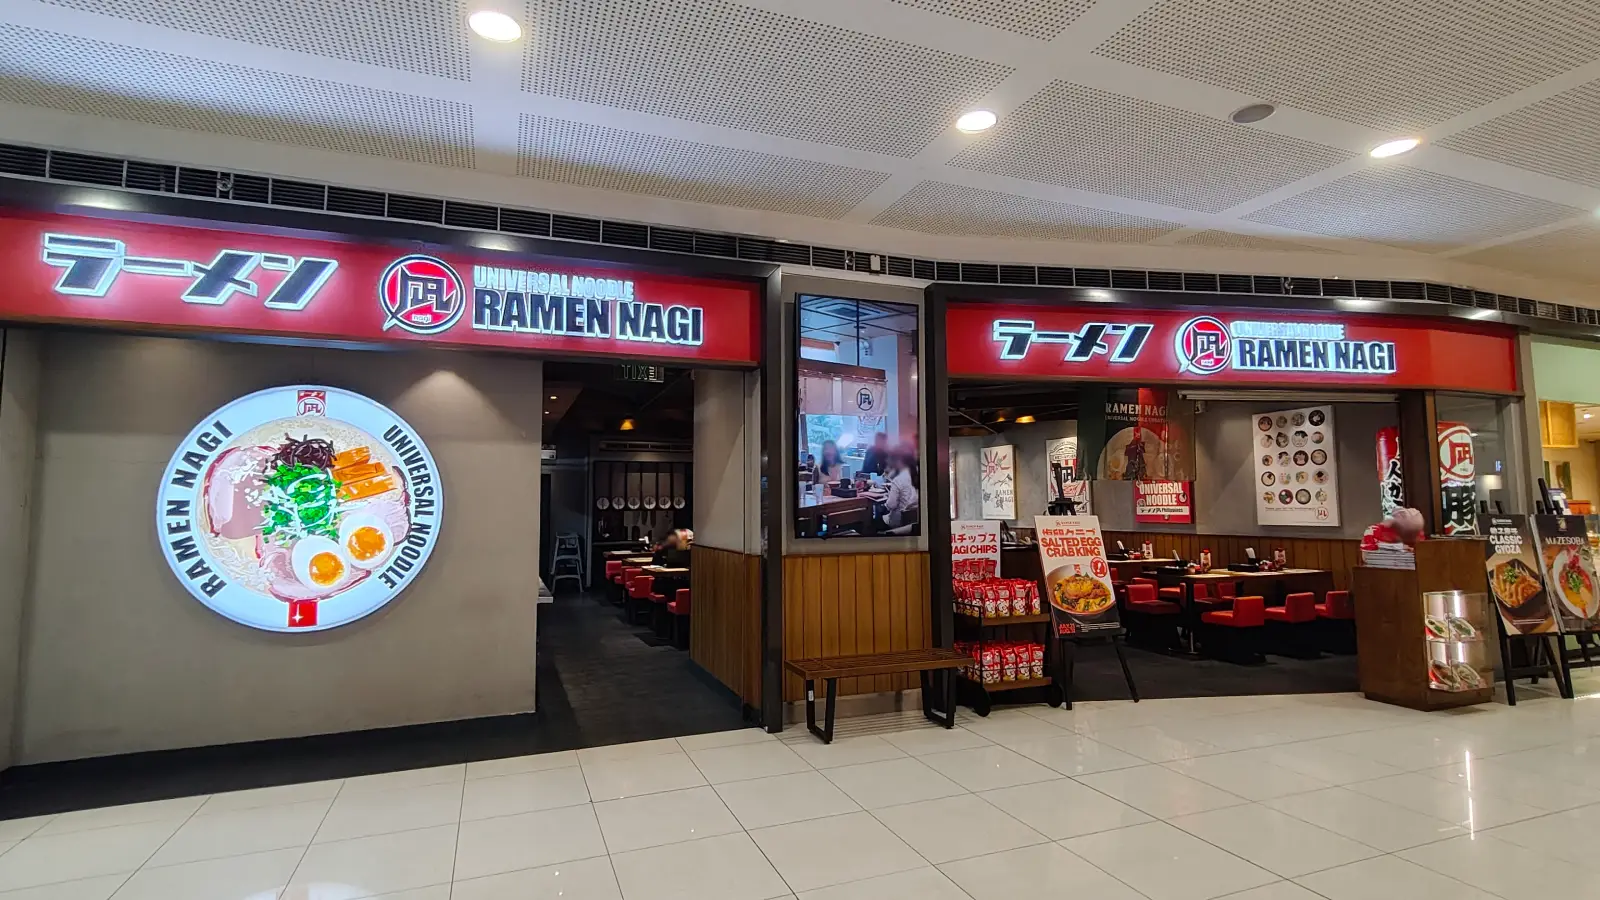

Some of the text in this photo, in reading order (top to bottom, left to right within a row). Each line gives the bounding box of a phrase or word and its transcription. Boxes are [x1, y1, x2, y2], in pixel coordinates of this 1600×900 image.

[43, 232, 339, 310] ラーメン
[473, 265, 635, 301] UNIVERSAL NOODLE
[472, 288, 704, 346] RAMEN NAGI
[993, 319, 1155, 363] ラーメン
[1234, 338, 1396, 373] RAMEN NAGI
[1105, 402, 1141, 415] RAMEN
[171, 420, 233, 489] NAGI
[383, 424, 434, 514] UNIVERSAL
[1139, 480, 1184, 495] UNIVERSAL
[1146, 494, 1178, 506] NOODLE
[166, 499, 228, 598] RAMEN
[377, 521, 432, 590] NOODLE
[951, 544, 998, 555] AGI CHIPS
[1041, 537, 1102, 548] SALTED EGG
[1047, 547, 1101, 558] CRAB KING
[1489, 535, 1523, 545] CLASSIC
[1495, 545, 1522, 554] GYOZA
